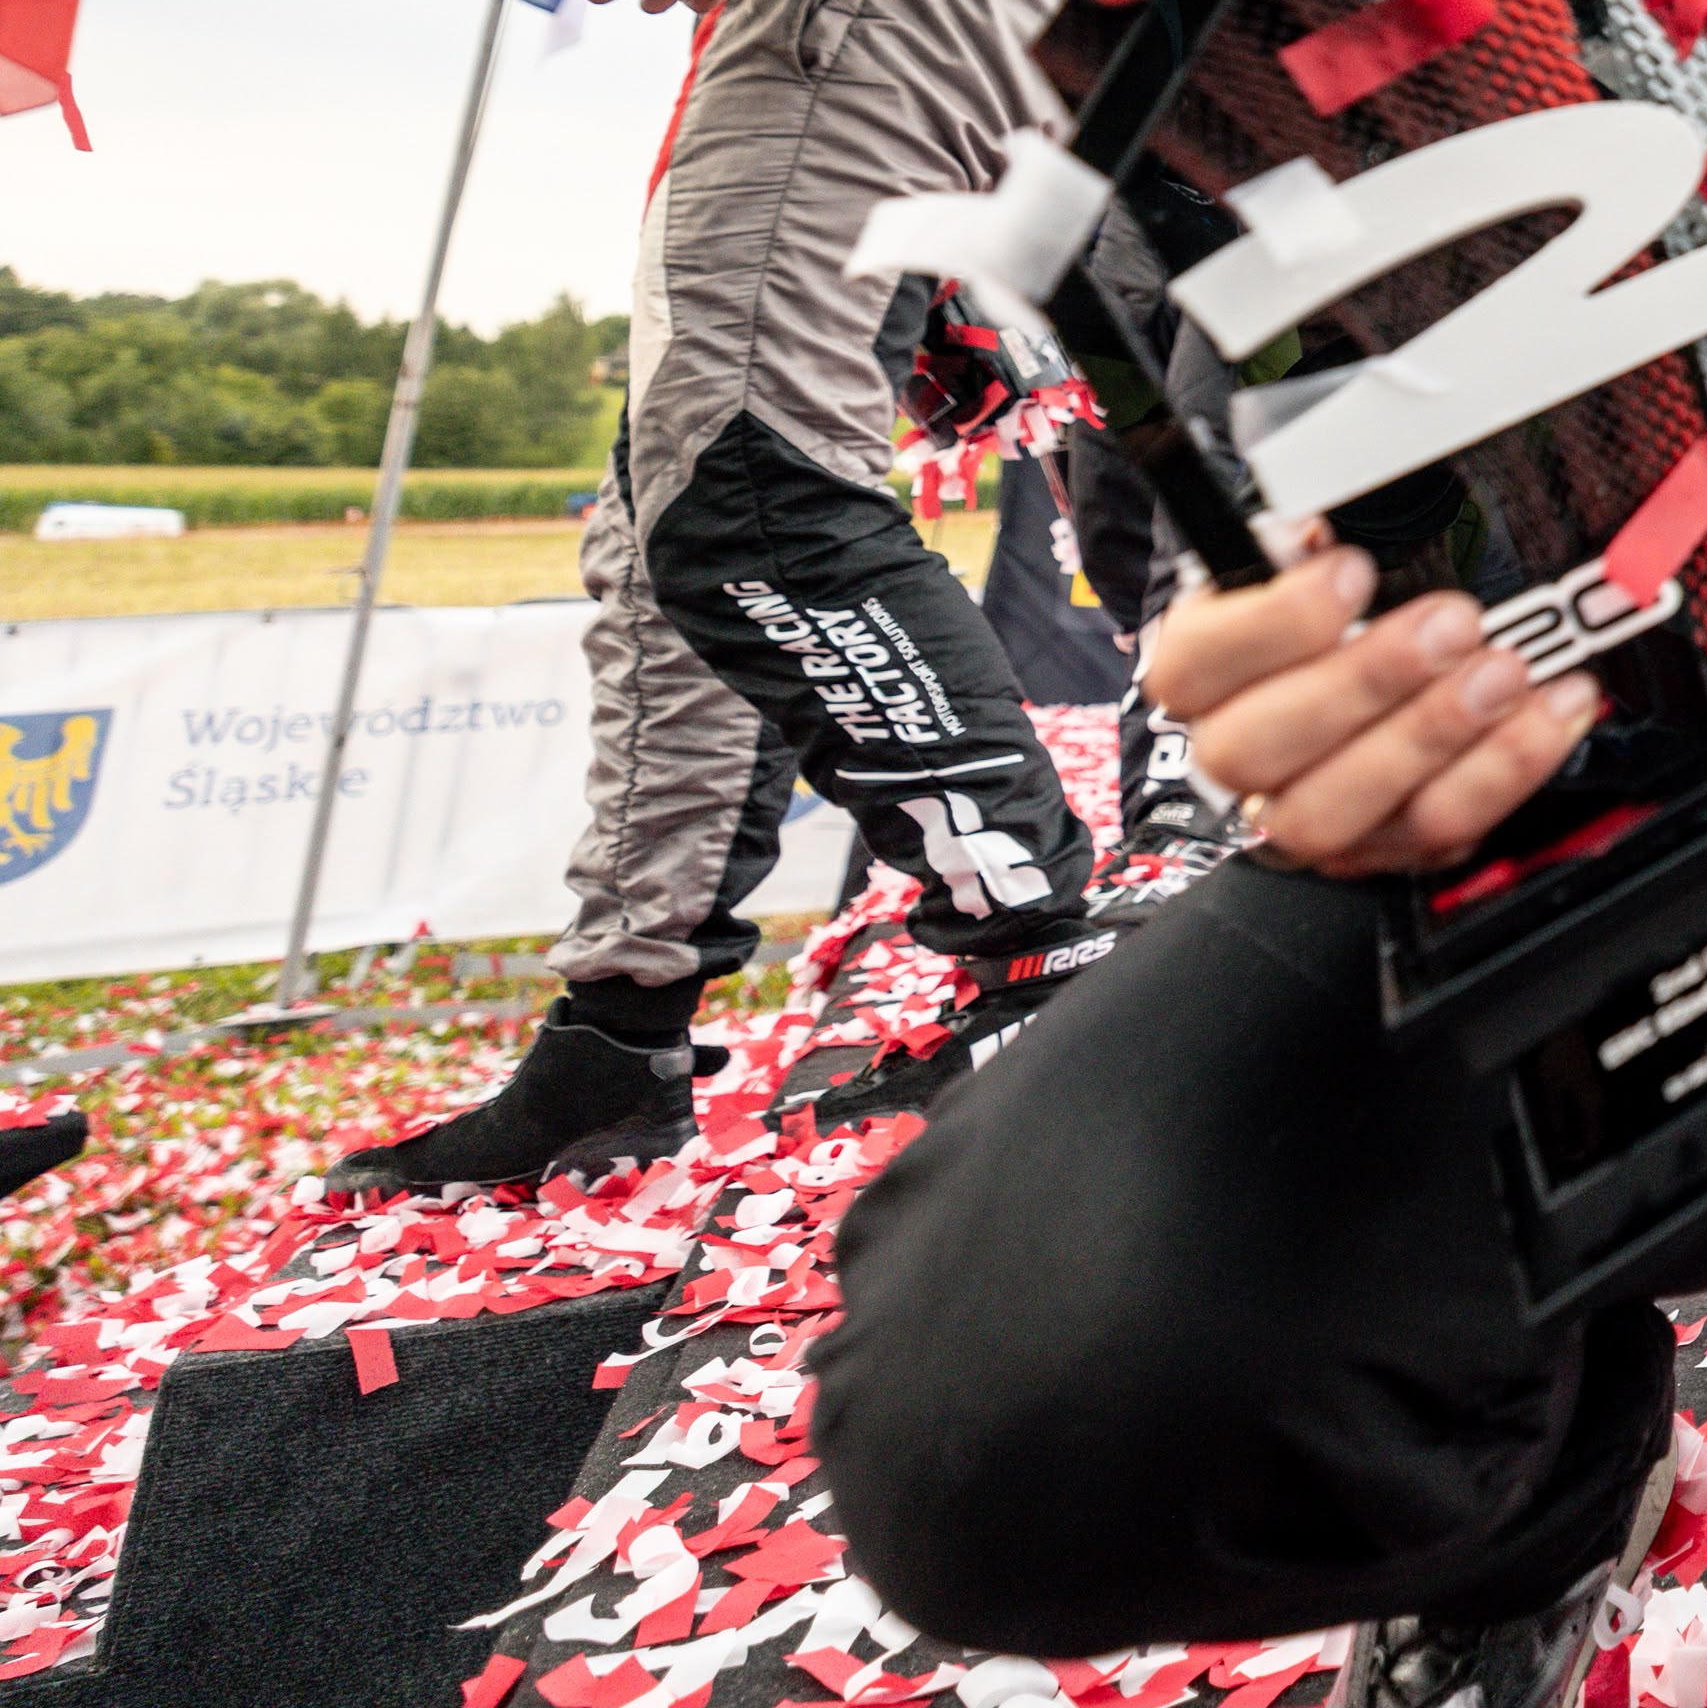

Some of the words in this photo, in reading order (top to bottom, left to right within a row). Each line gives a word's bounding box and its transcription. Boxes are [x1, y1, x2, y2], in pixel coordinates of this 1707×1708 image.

[722, 580, 851, 678] RACING
[804, 607, 942, 744] FACTORY
[906, 658, 968, 738] MOTORSPORT
[813, 682, 891, 745] THE
[162, 760, 369, 815] Śląske
[1041, 930, 1117, 976] RRS
